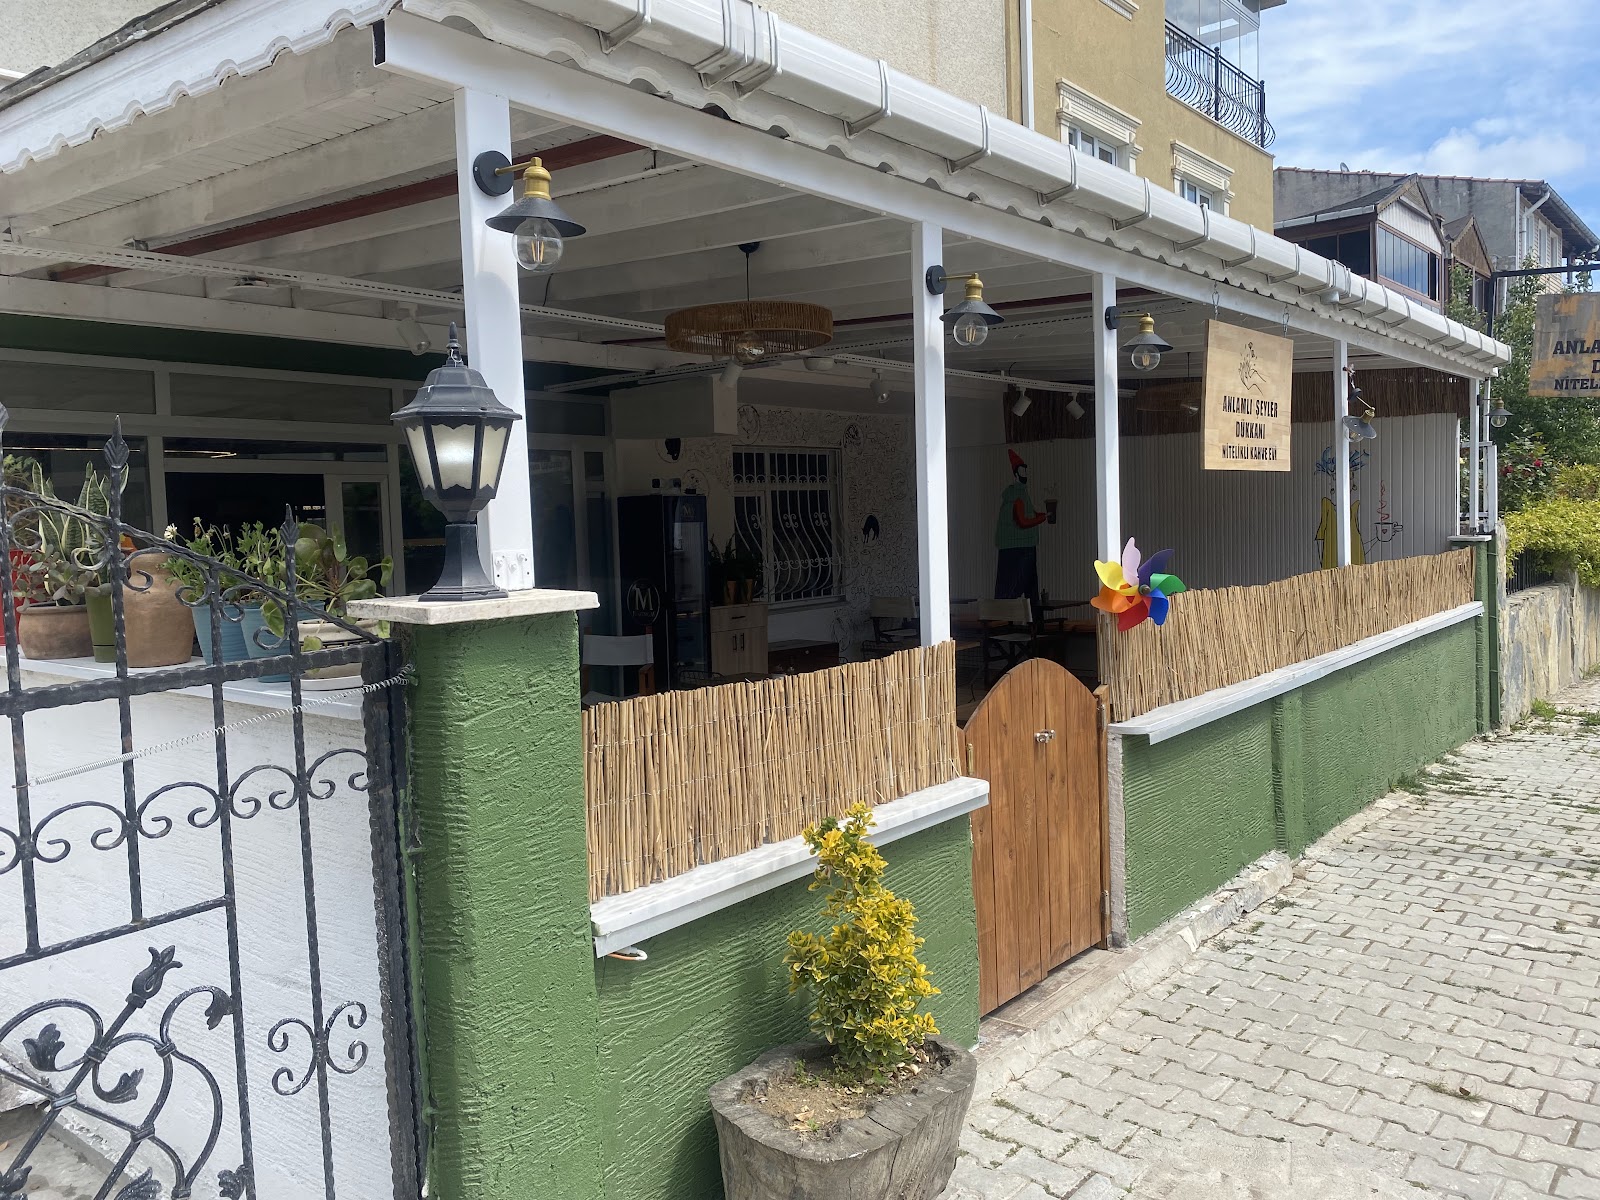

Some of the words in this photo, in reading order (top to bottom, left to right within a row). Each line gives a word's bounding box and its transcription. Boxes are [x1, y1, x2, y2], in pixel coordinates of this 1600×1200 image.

[1554, 376, 1600, 390] NİTEL
[1222, 395, 1253, 415] ANLAMLI
[1255, 399, 1278, 419] ŞEYLER
[1235, 419, 1266, 440] DÜKKANI
[1222, 443, 1249, 460] NİTELİKLİ
[1250, 445, 1268, 460] KAHVE
